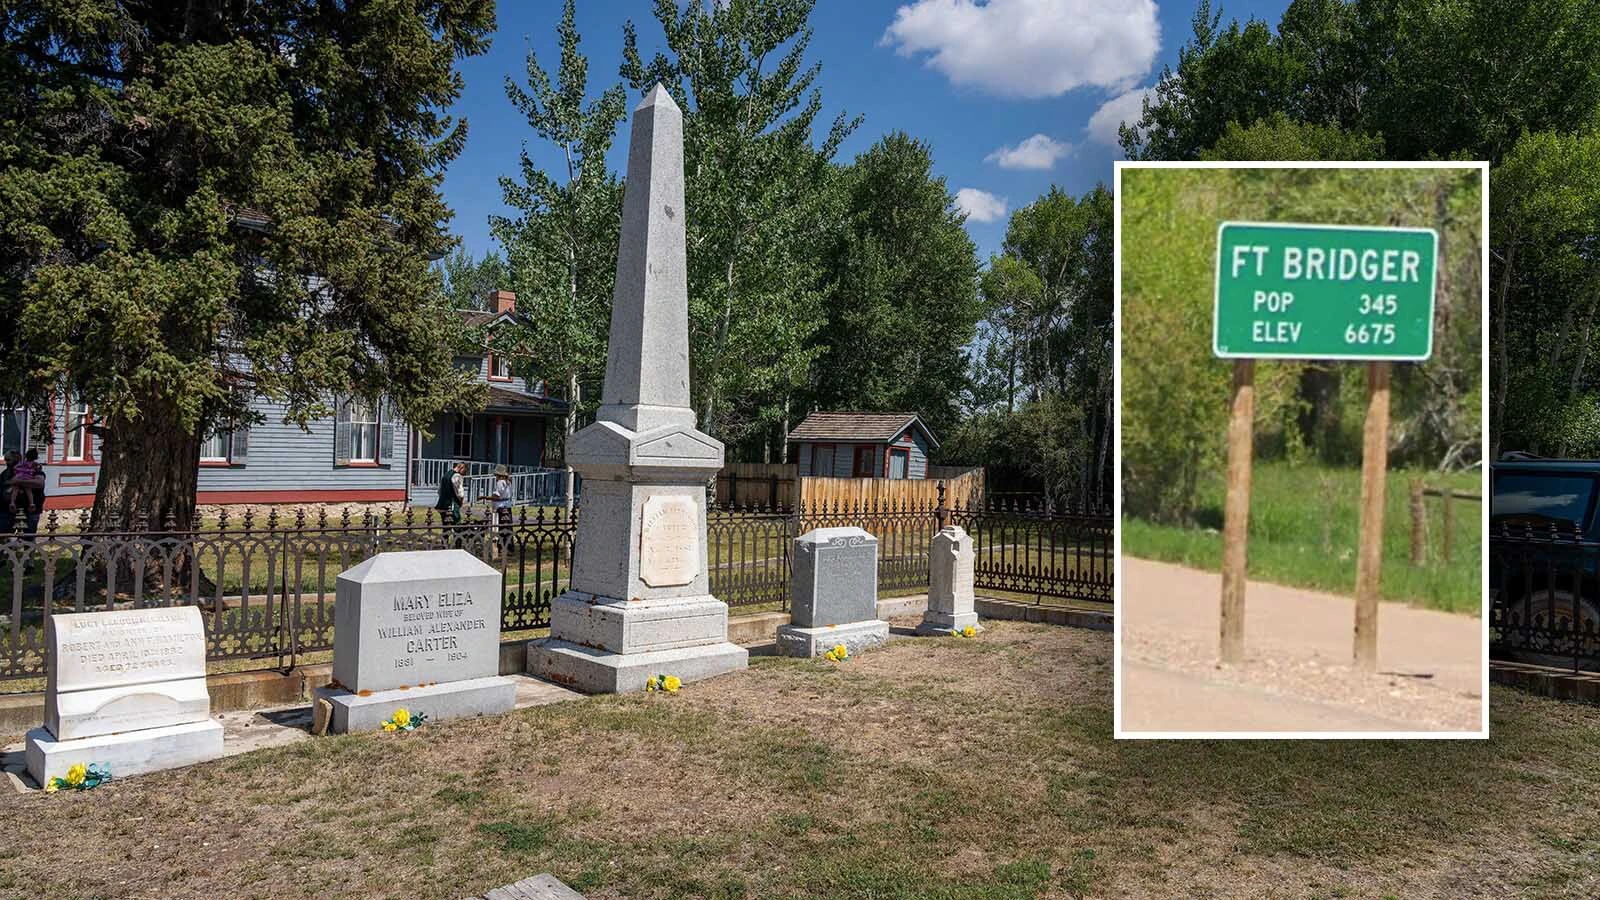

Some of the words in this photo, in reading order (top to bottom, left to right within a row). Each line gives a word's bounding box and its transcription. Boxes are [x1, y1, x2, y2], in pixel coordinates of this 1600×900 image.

[1232, 245, 1269, 278] FT
[1283, 247, 1420, 282] BRIDGER
[1253, 290, 1295, 312] POP
[1359, 294, 1397, 315] 345
[1253, 321, 1302, 343] ELEV
[1344, 324, 1396, 344] 6675
[393, 594, 433, 611] MARY
[438, 592, 473, 607] ELIZA
[378, 625, 422, 639] WILLIAM
[428, 619, 486, 634] ALEXANDER
[407, 636, 458, 653] CARTER
